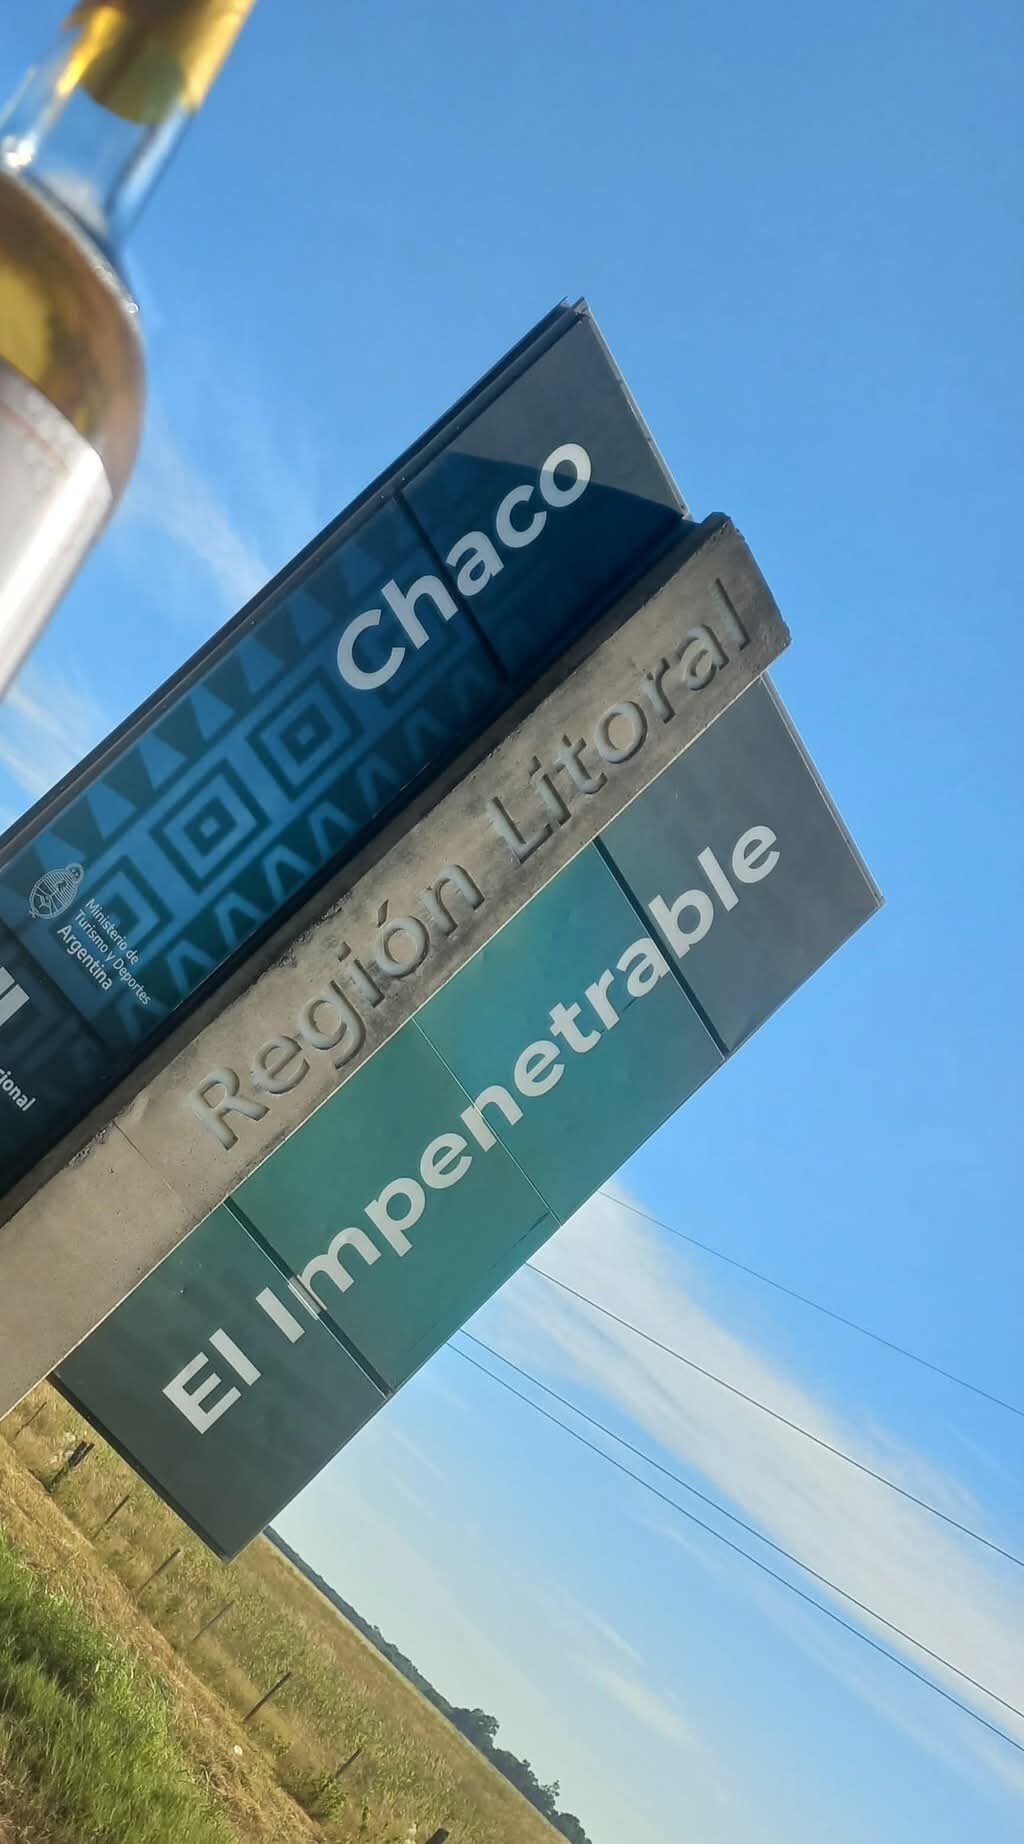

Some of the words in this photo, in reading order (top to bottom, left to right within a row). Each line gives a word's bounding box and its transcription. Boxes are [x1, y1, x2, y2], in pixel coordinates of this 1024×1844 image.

[335, 442, 594, 691] Chaco
[85, 898, 127, 950] Ministerio
[126, 949, 139, 965] de
[187, 861, 486, 1151] Región
[484, 577, 753, 864] Litoral
[57, 924, 112, 991] Argentina
[75, 909, 108, 952] Turismo
[106, 951, 115, 962] y
[112, 958, 151, 1005] Deportes
[162, 1328, 262, 1434] El
[255, 824, 782, 1344] Impenetrable
